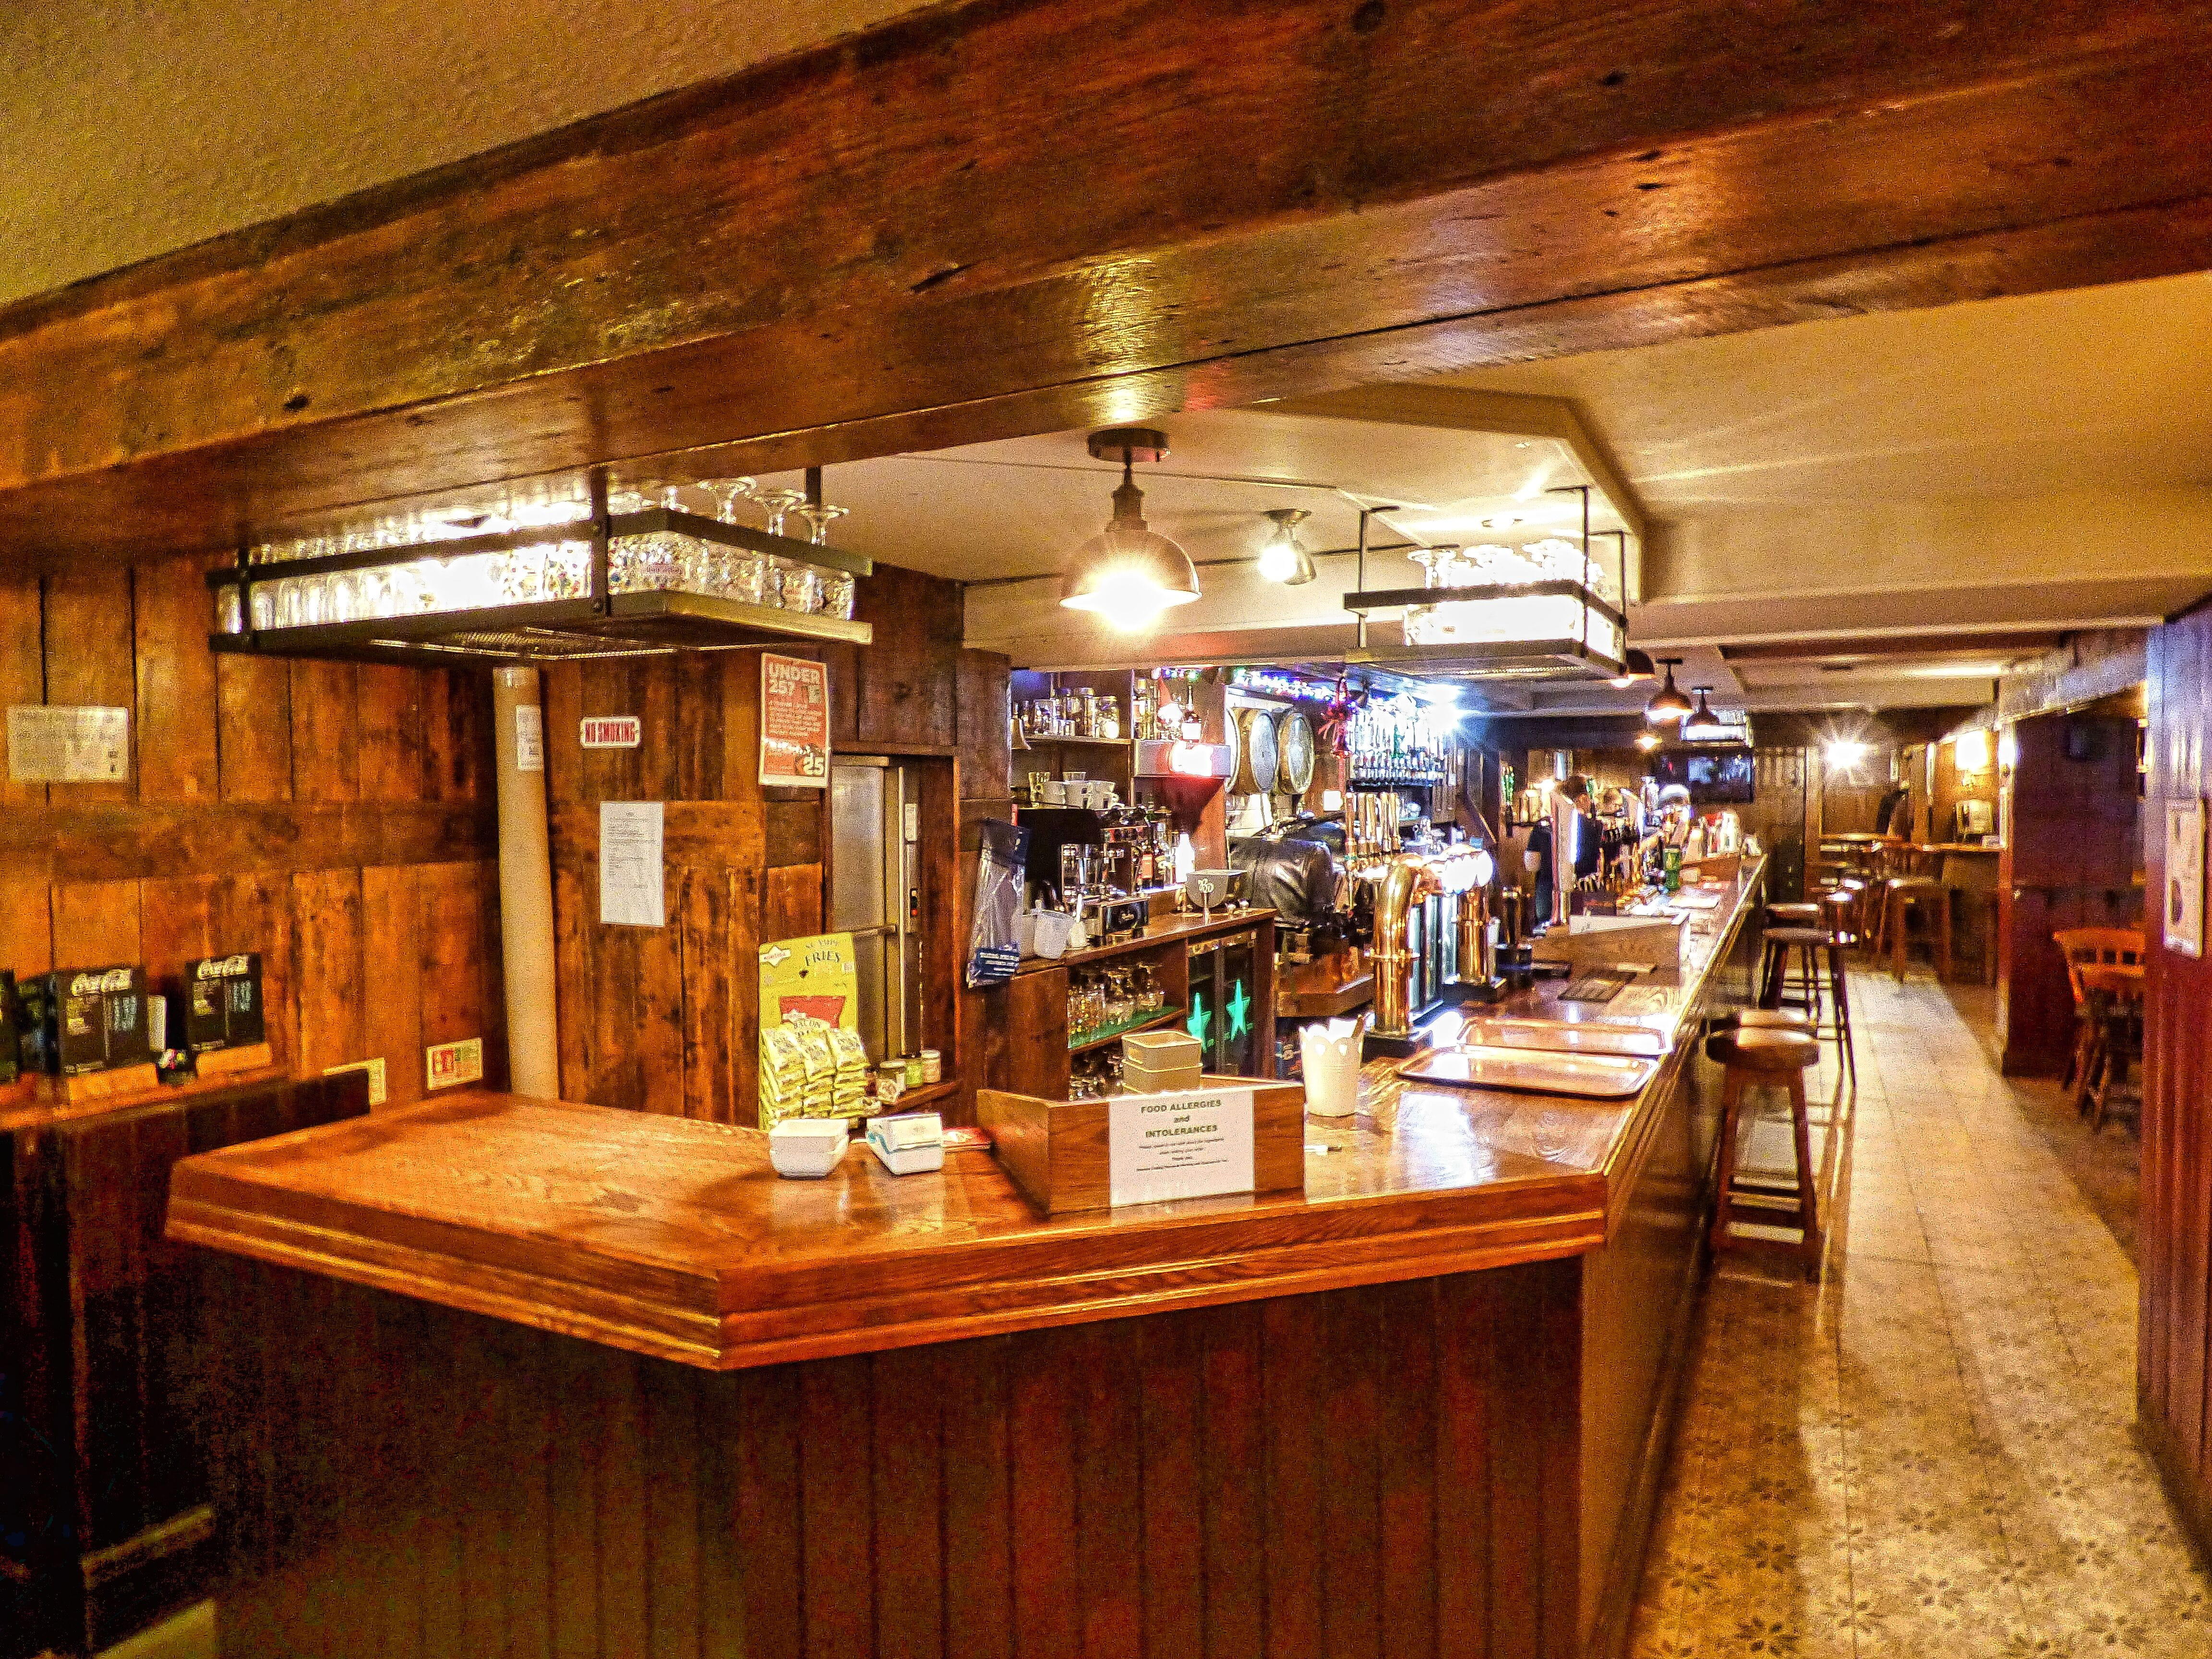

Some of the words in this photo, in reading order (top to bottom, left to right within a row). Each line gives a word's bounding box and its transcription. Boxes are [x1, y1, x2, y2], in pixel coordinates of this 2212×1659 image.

[769, 662, 820, 684] UNDER
[803, 755, 825, 776] 25
[805, 950, 840, 966] FRIES
[1141, 1105, 1167, 1114] FOOD
[1170, 1099, 1221, 1111] ALLERGIES
[1174, 1115, 1190, 1123] and
[1145, 1124, 1218, 1138] INTOLERANCES
